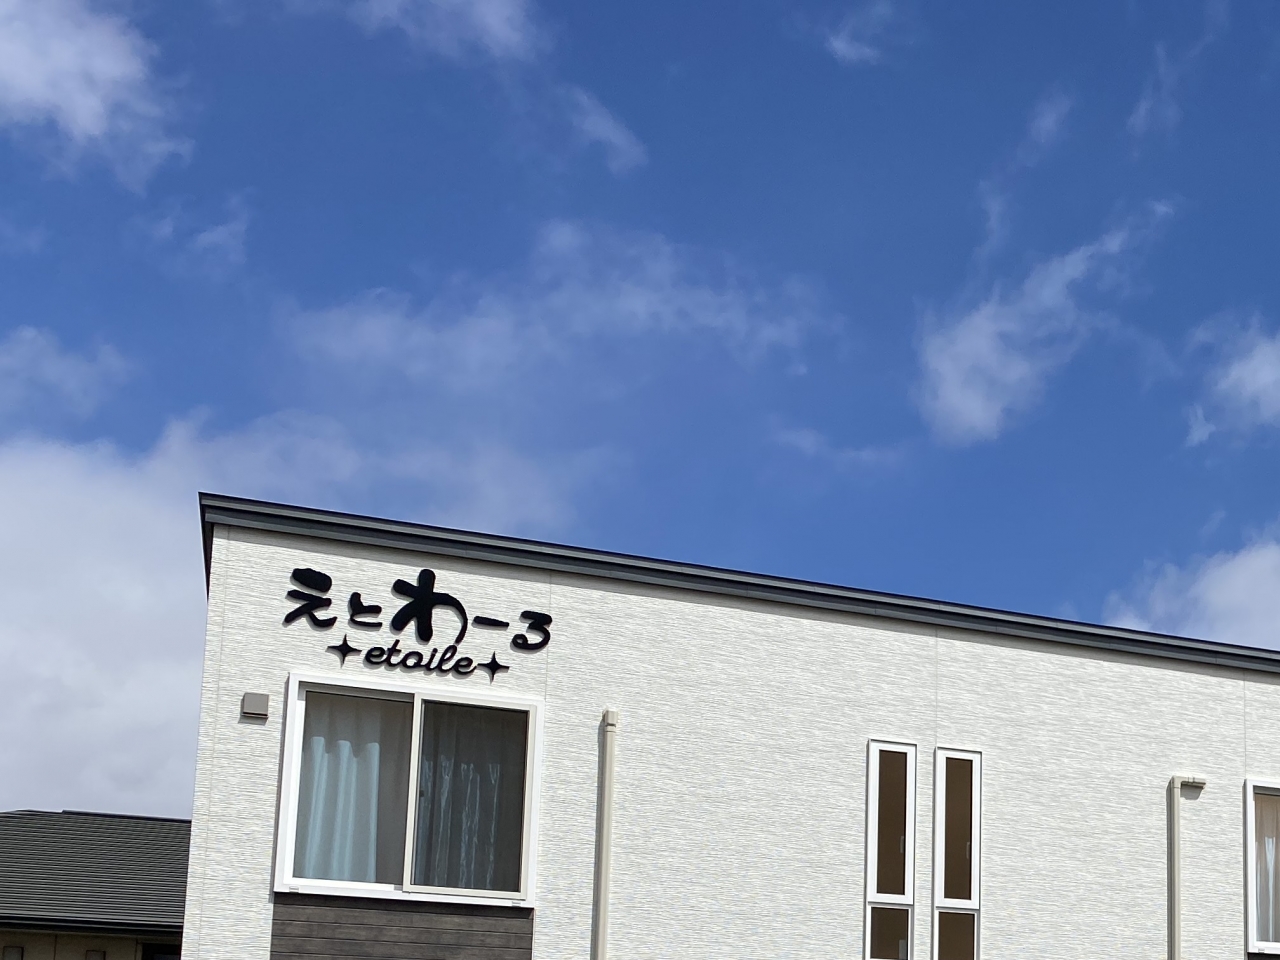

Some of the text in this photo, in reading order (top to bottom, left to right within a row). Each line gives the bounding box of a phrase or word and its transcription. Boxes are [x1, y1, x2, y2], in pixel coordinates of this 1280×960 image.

[284, 568, 552, 650] えとわーる
[364, 639, 478, 676] etoile
